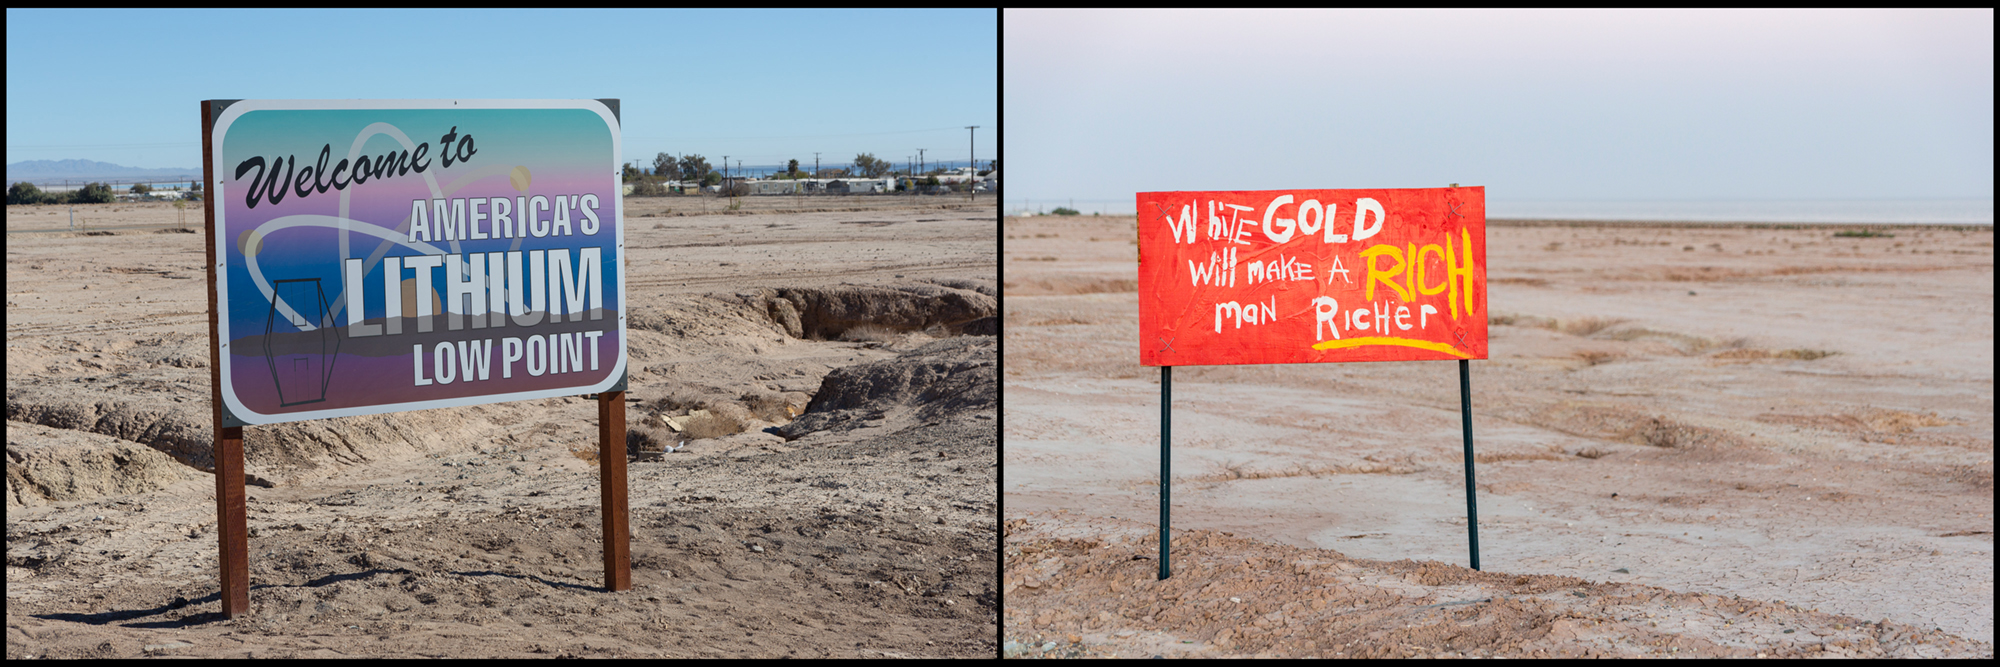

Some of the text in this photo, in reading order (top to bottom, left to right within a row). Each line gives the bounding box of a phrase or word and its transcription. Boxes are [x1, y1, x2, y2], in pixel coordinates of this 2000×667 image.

[235, 126, 478, 208] Welcome to
[408, 193, 600, 243] AMERICA'S
[1262, 194, 1385, 244] GOLD
[345, 247, 603, 338] LITHIUM
[1188, 247, 1237, 288] Will
[1328, 255, 1352, 285] A
[1358, 226, 1474, 321] RICH
[413, 330, 603, 386] LOW POINT
